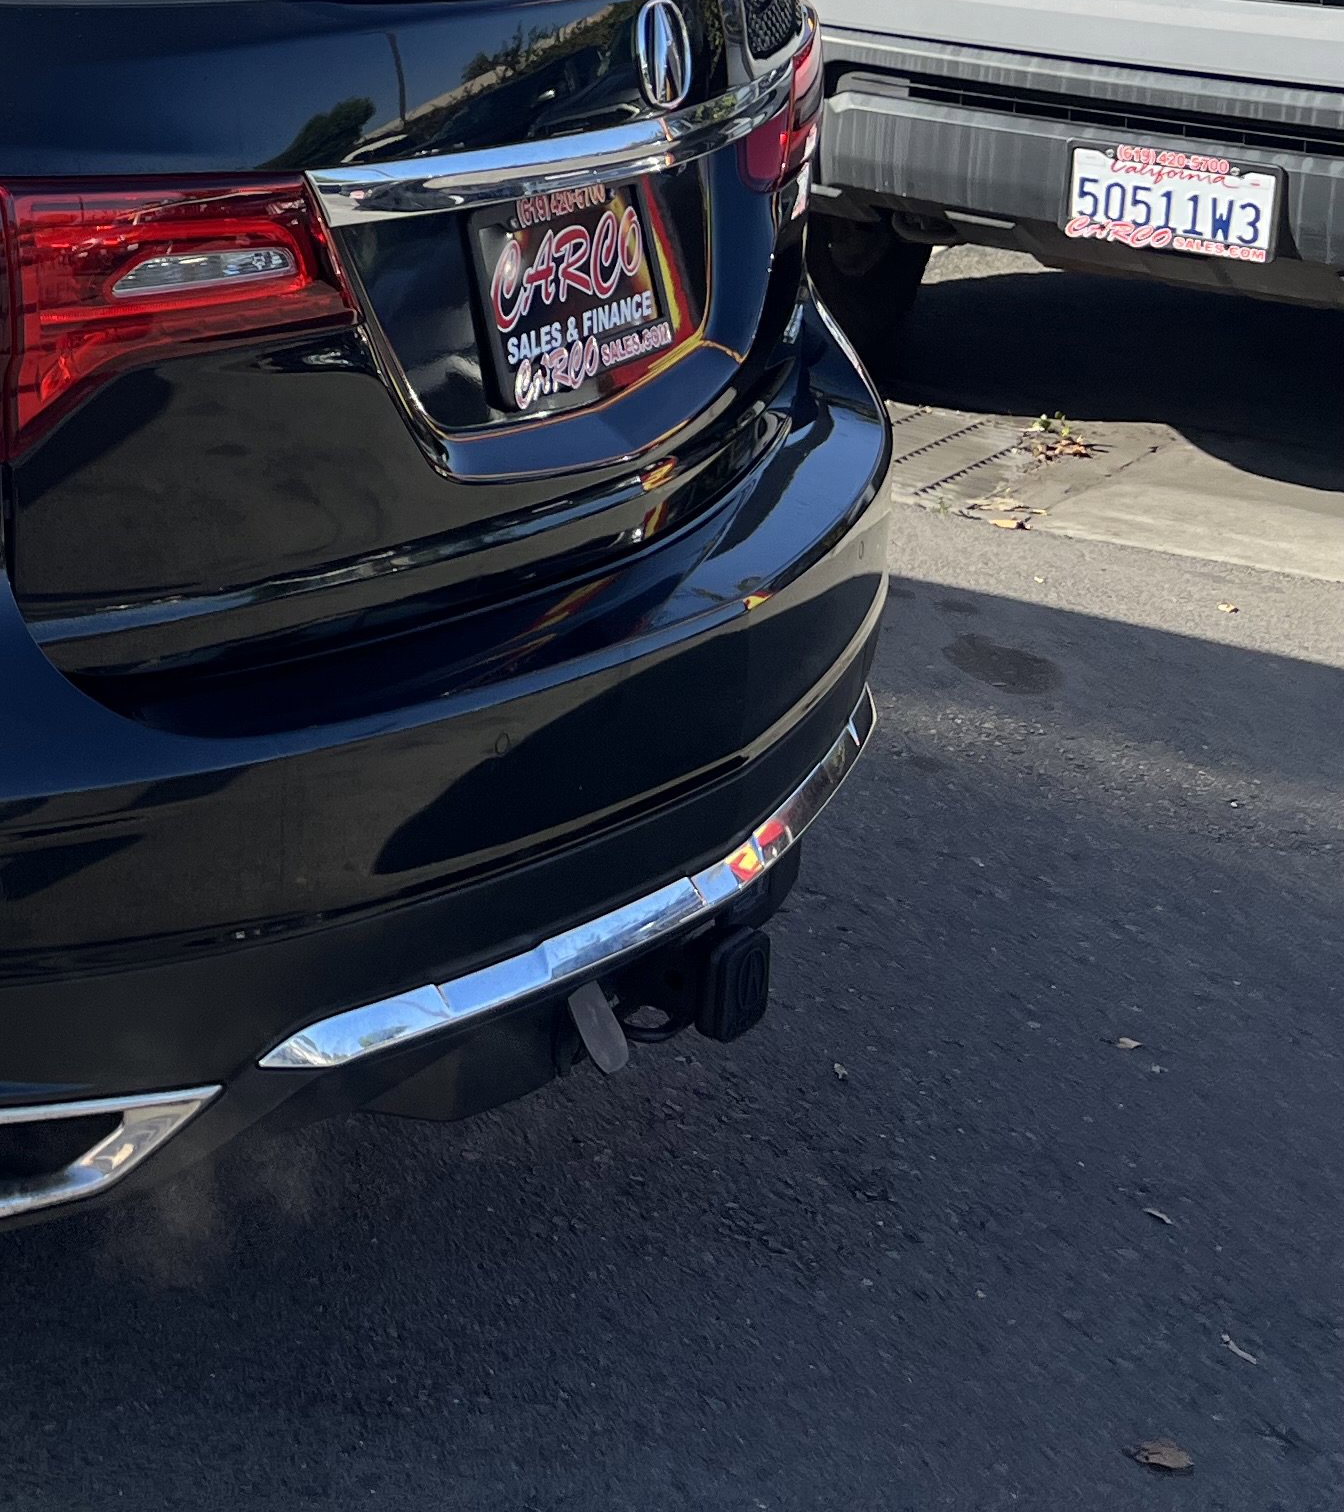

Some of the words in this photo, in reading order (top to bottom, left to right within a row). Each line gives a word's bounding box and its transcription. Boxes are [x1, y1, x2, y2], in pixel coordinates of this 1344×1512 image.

[1064, 215, 1172, 248] CARCO
[1173, 236, 1266, 263] SALES.COM
[1078, 176, 1261, 245] 50511W3
[490, 206, 642, 332] CARCO
[507, 325, 563, 365] SALES
[566, 316, 579, 342] &
[582, 290, 653, 337] FINANCE
